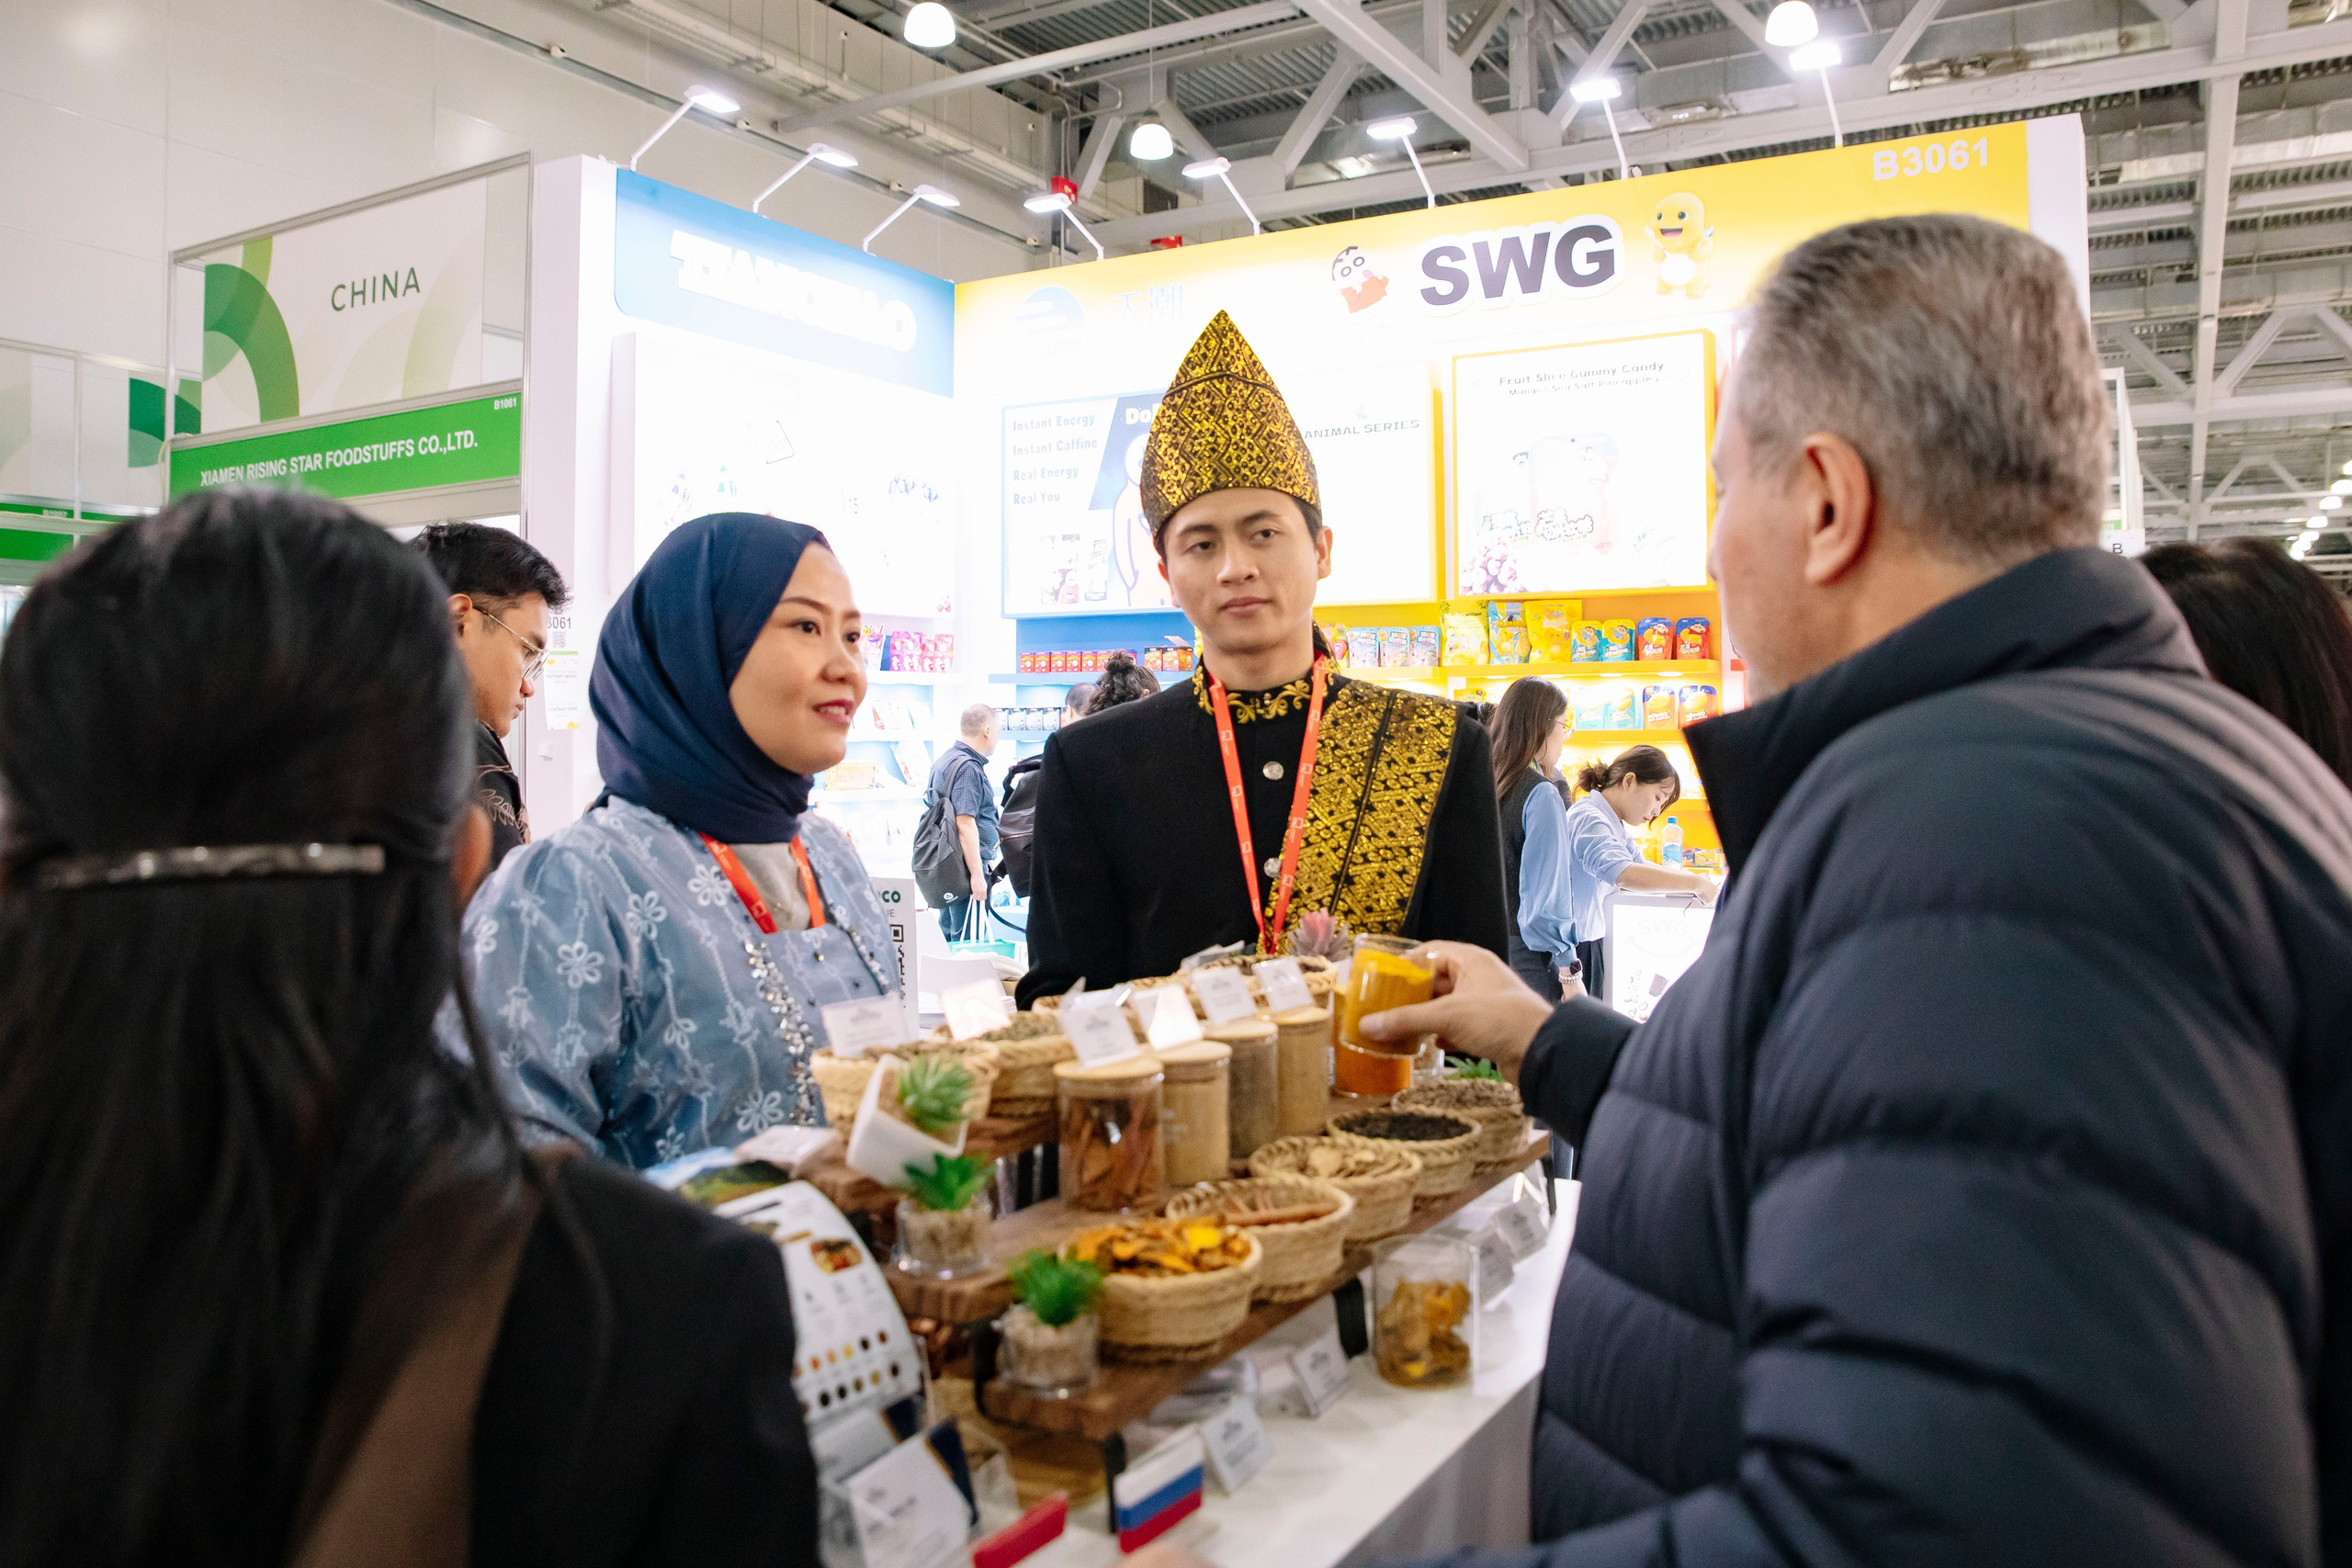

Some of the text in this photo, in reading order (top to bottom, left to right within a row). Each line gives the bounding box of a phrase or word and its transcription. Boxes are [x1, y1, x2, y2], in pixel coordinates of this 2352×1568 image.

[1872, 137, 1987, 181] B3061
[1420, 224, 1614, 306] SWG
[331, 266, 421, 311] CHINA
[1499, 376, 1531, 386] Fruit
[1571, 368, 1617, 379] Gummy
[1622, 362, 1665, 374] Candy
[494, 397, 517, 411] B1061
[1013, 414, 1095, 432] Instant Energy
[1305, 419, 1419, 439] ANIMAL SERIES
[1013, 438, 1098, 456] Instant Caffine
[200, 429, 479, 487] XIAMEN RISING STAR FOODSTUFFS CO.,LTD.
[1013, 467, 1079, 481] Real Energy
[1013, 491, 1060, 504] Real You
